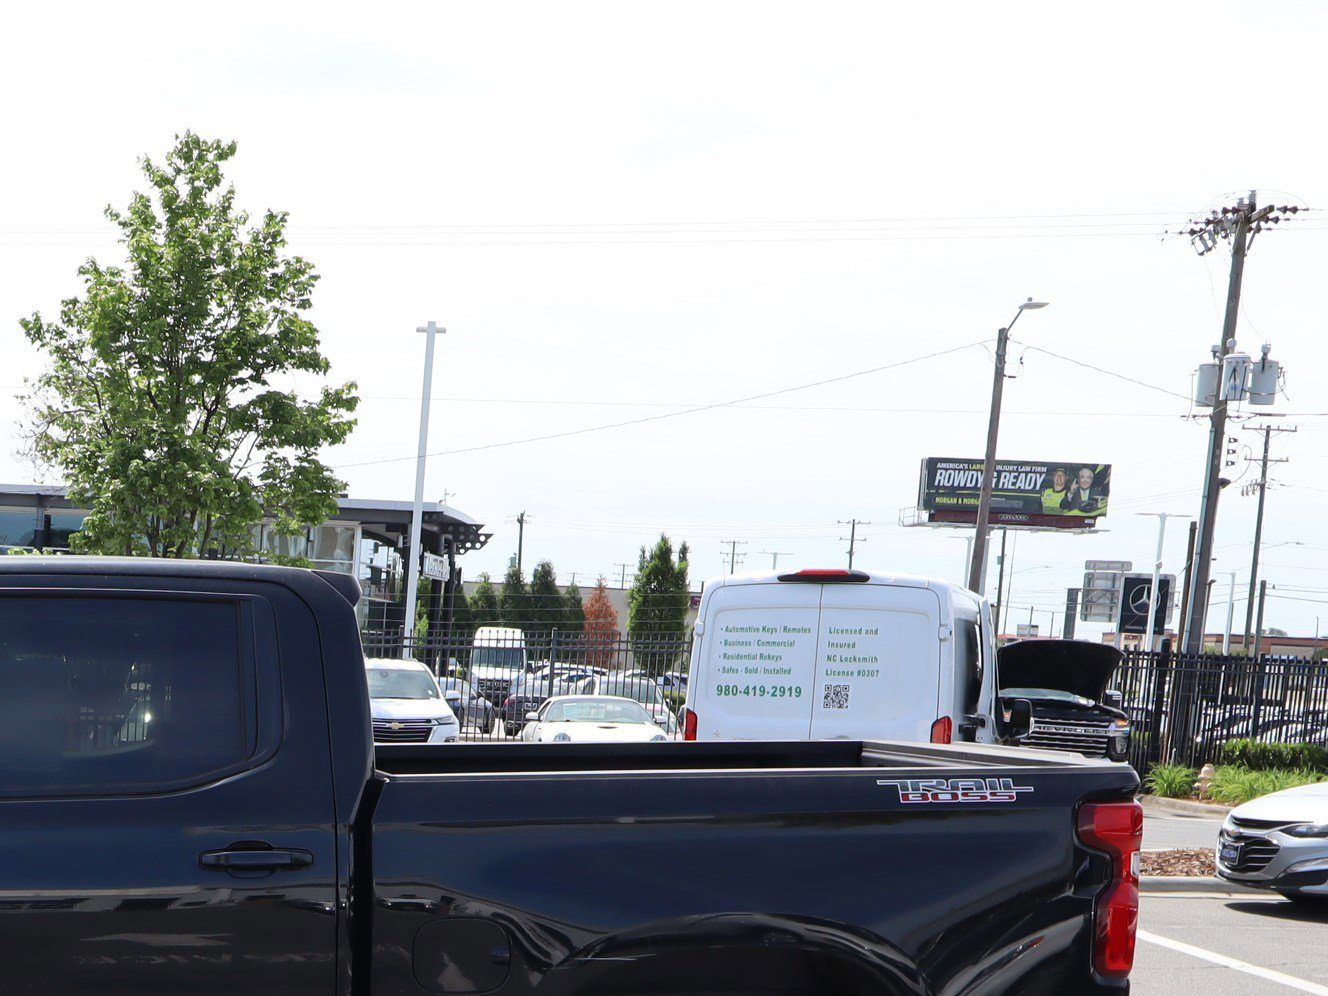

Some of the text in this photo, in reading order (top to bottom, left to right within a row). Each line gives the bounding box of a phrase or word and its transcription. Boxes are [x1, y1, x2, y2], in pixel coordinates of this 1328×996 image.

[936, 462, 968, 470] AMERICA'S
[934, 470, 984, 488] ROWDY
[999, 472, 1047, 490] READY
[935, 496, 958, 504] MORGAN
[762, 626, 778, 635] Keys
[783, 626, 811, 634] Remotes
[828, 627, 863, 635] Licensed
[723, 639, 752, 647] Business
[756, 639, 796, 648] Commercial
[827, 641, 856, 649] Insured
[722, 653, 783, 662] Residential Rekeys
[840, 655, 879, 663] Locksmith
[722, 666, 739, 674] Safes
[763, 667, 792, 675] Installed
[826, 669, 855, 677] License
[716, 684, 802, 697] 980-419-2919
[877, 778, 1034, 793] TRAIL
[900, 791, 1016, 803] BOSS
